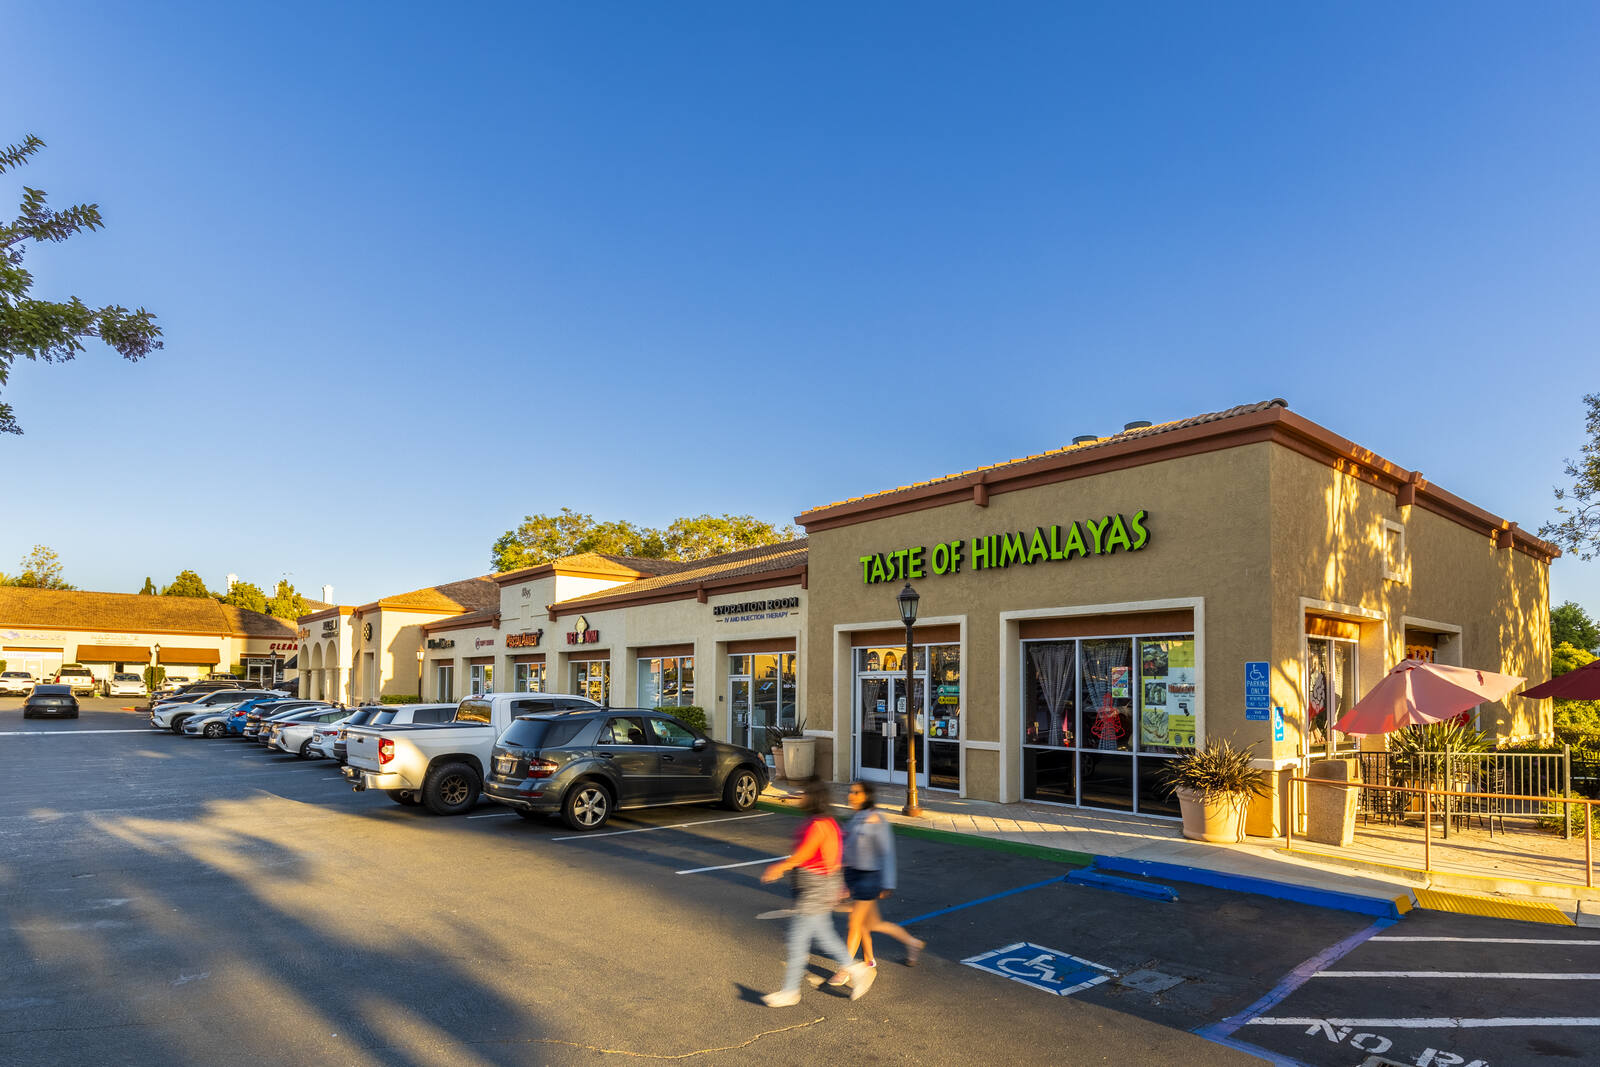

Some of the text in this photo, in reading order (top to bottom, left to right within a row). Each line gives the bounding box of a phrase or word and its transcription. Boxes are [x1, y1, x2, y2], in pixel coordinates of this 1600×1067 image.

[860, 510, 1150, 584] TASTE OF HIMALAYAS
[713, 597, 799, 615] HYDRATION ROOM
[740, 613, 764, 621] INJECTION
[766, 611, 788, 619] THERAPY
[1247, 680, 1269, 688] PARKING
[1304, 1018, 1393, 1054] NO
